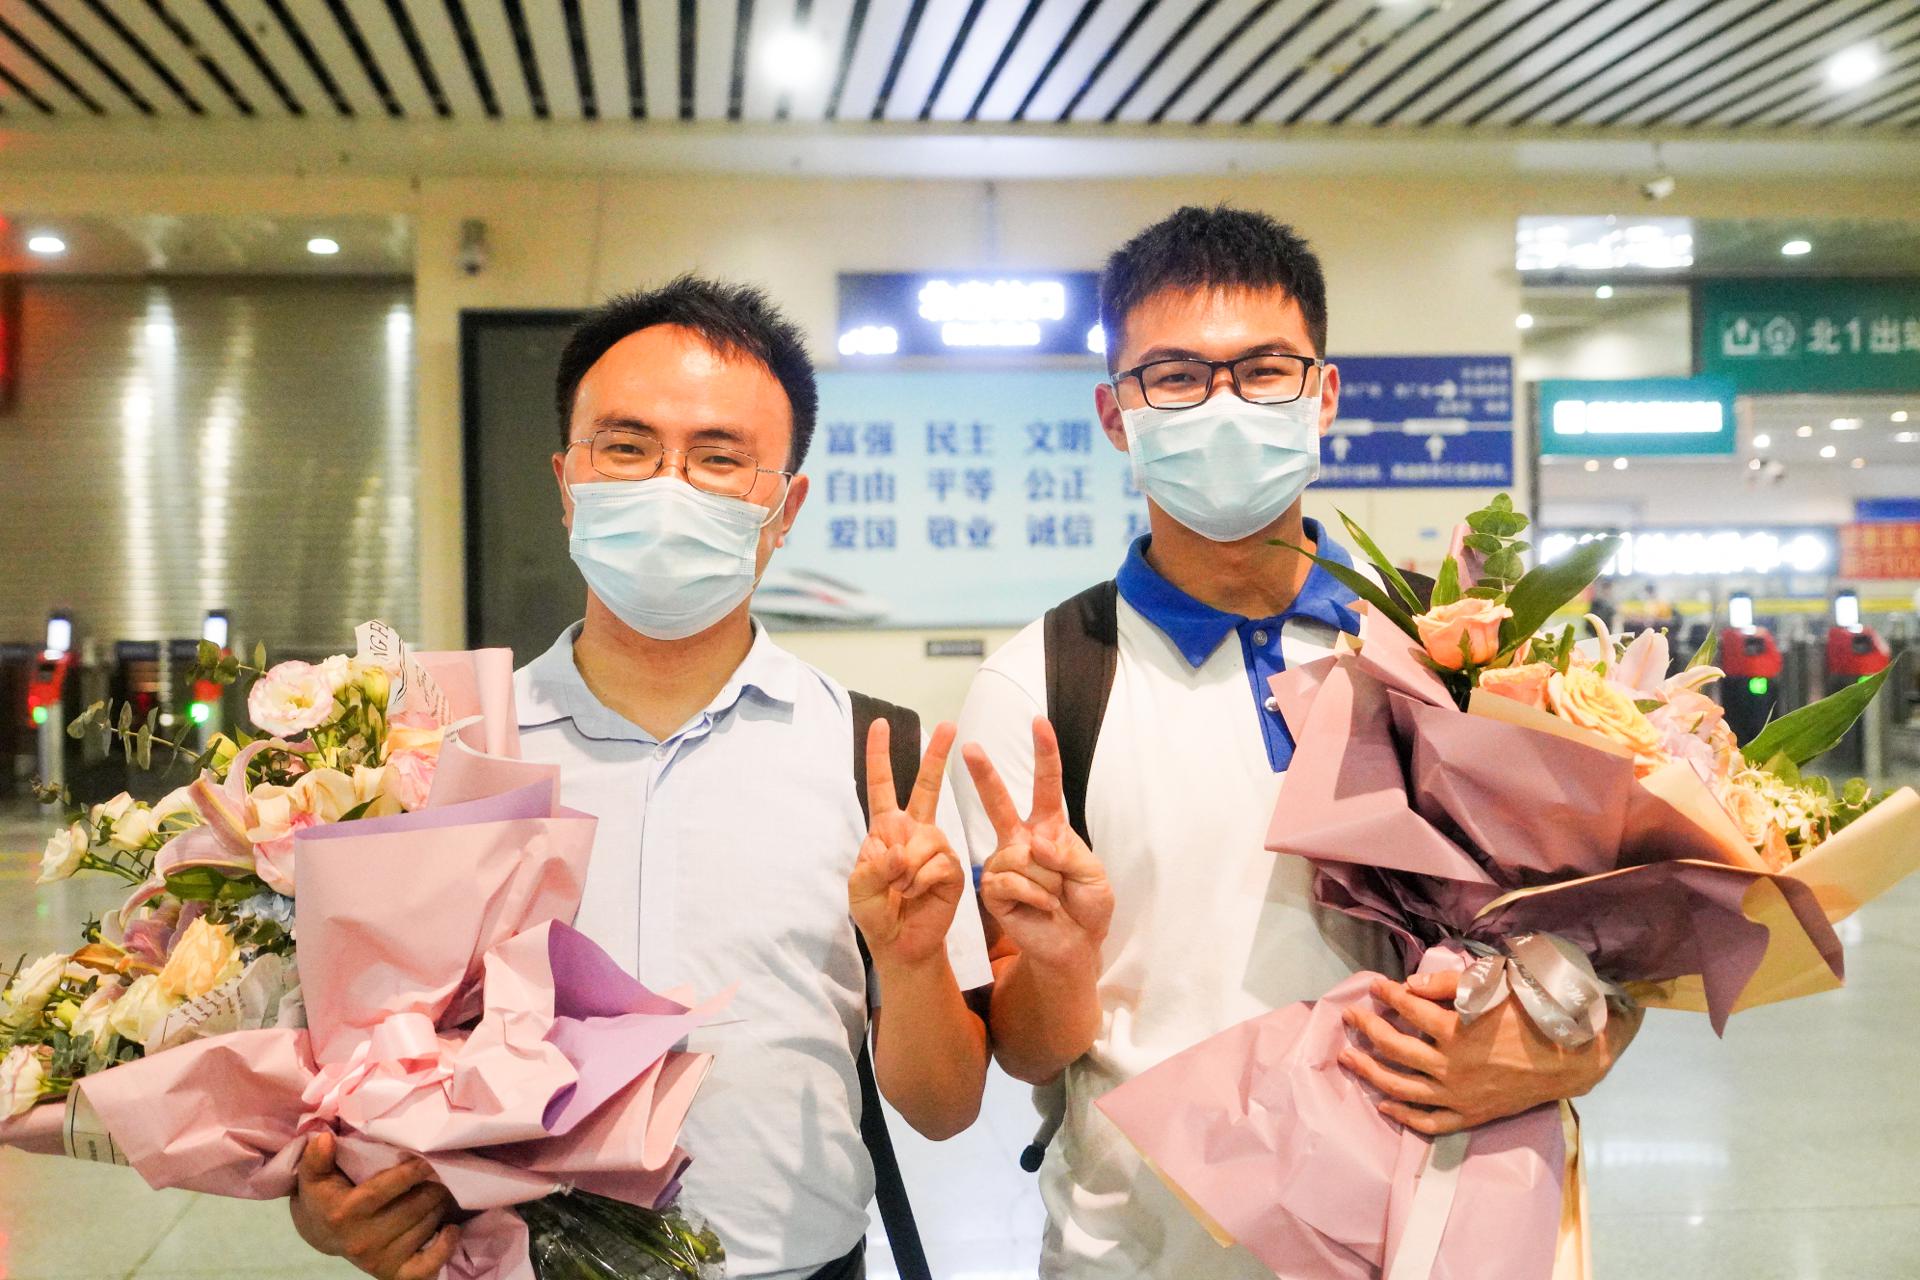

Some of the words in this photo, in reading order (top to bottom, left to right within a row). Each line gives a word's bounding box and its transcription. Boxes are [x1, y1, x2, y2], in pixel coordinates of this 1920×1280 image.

[825, 421, 894, 455] 富强
[927, 420, 995, 455] 民主
[1025, 420, 1092, 454] 文明
[826, 467, 895, 503] 自由
[928, 468, 994, 503] 平等
[1026, 468, 1092, 501] 公正
[828, 515, 896, 549] 爱国
[927, 515, 995, 548] 敬业
[1028, 515, 1093, 547] 诚信
